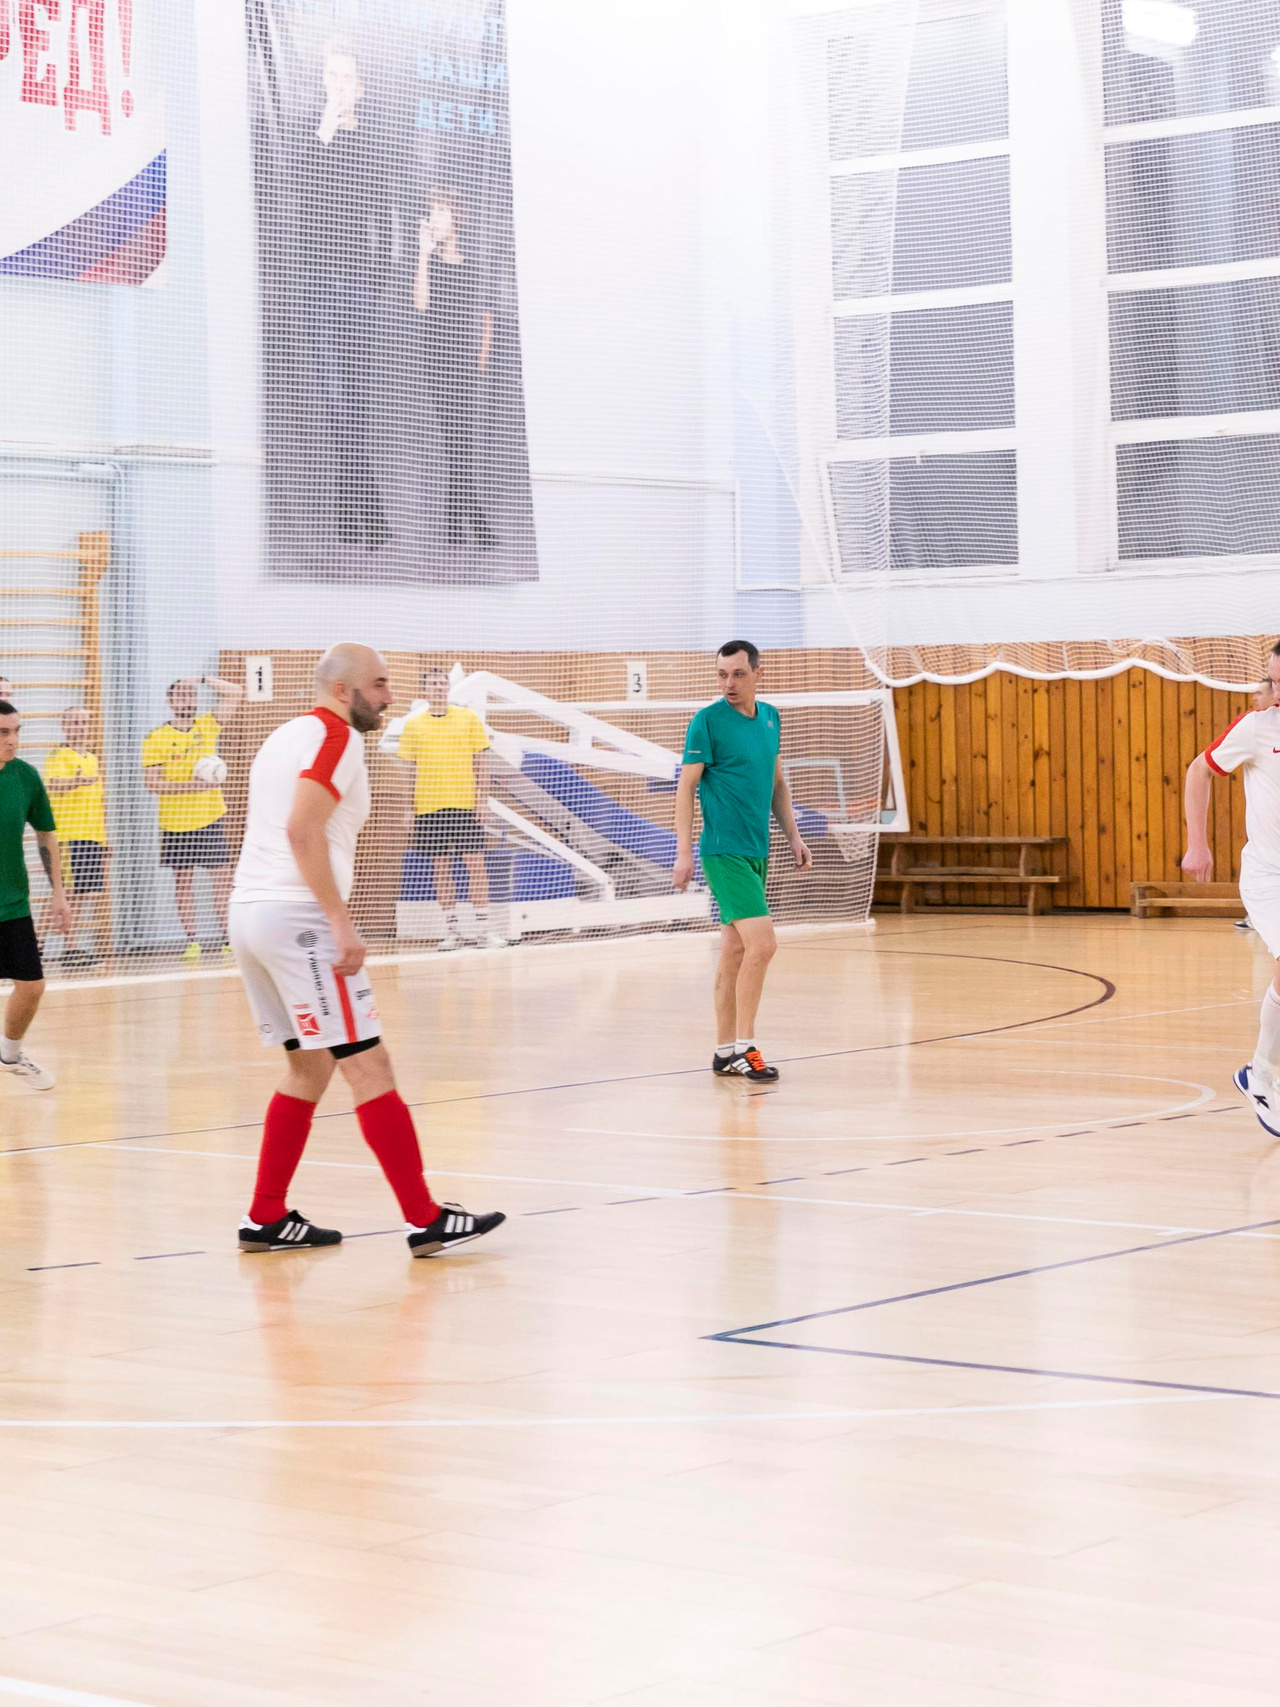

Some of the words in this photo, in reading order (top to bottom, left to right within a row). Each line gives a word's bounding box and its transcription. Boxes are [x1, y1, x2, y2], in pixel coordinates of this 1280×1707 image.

[0, 0, 134, 136] ЕД!
[414, 98, 498, 137] ДЕТИ
[255, 666, 264, 692] 1
[632, 673, 643, 693] 3
